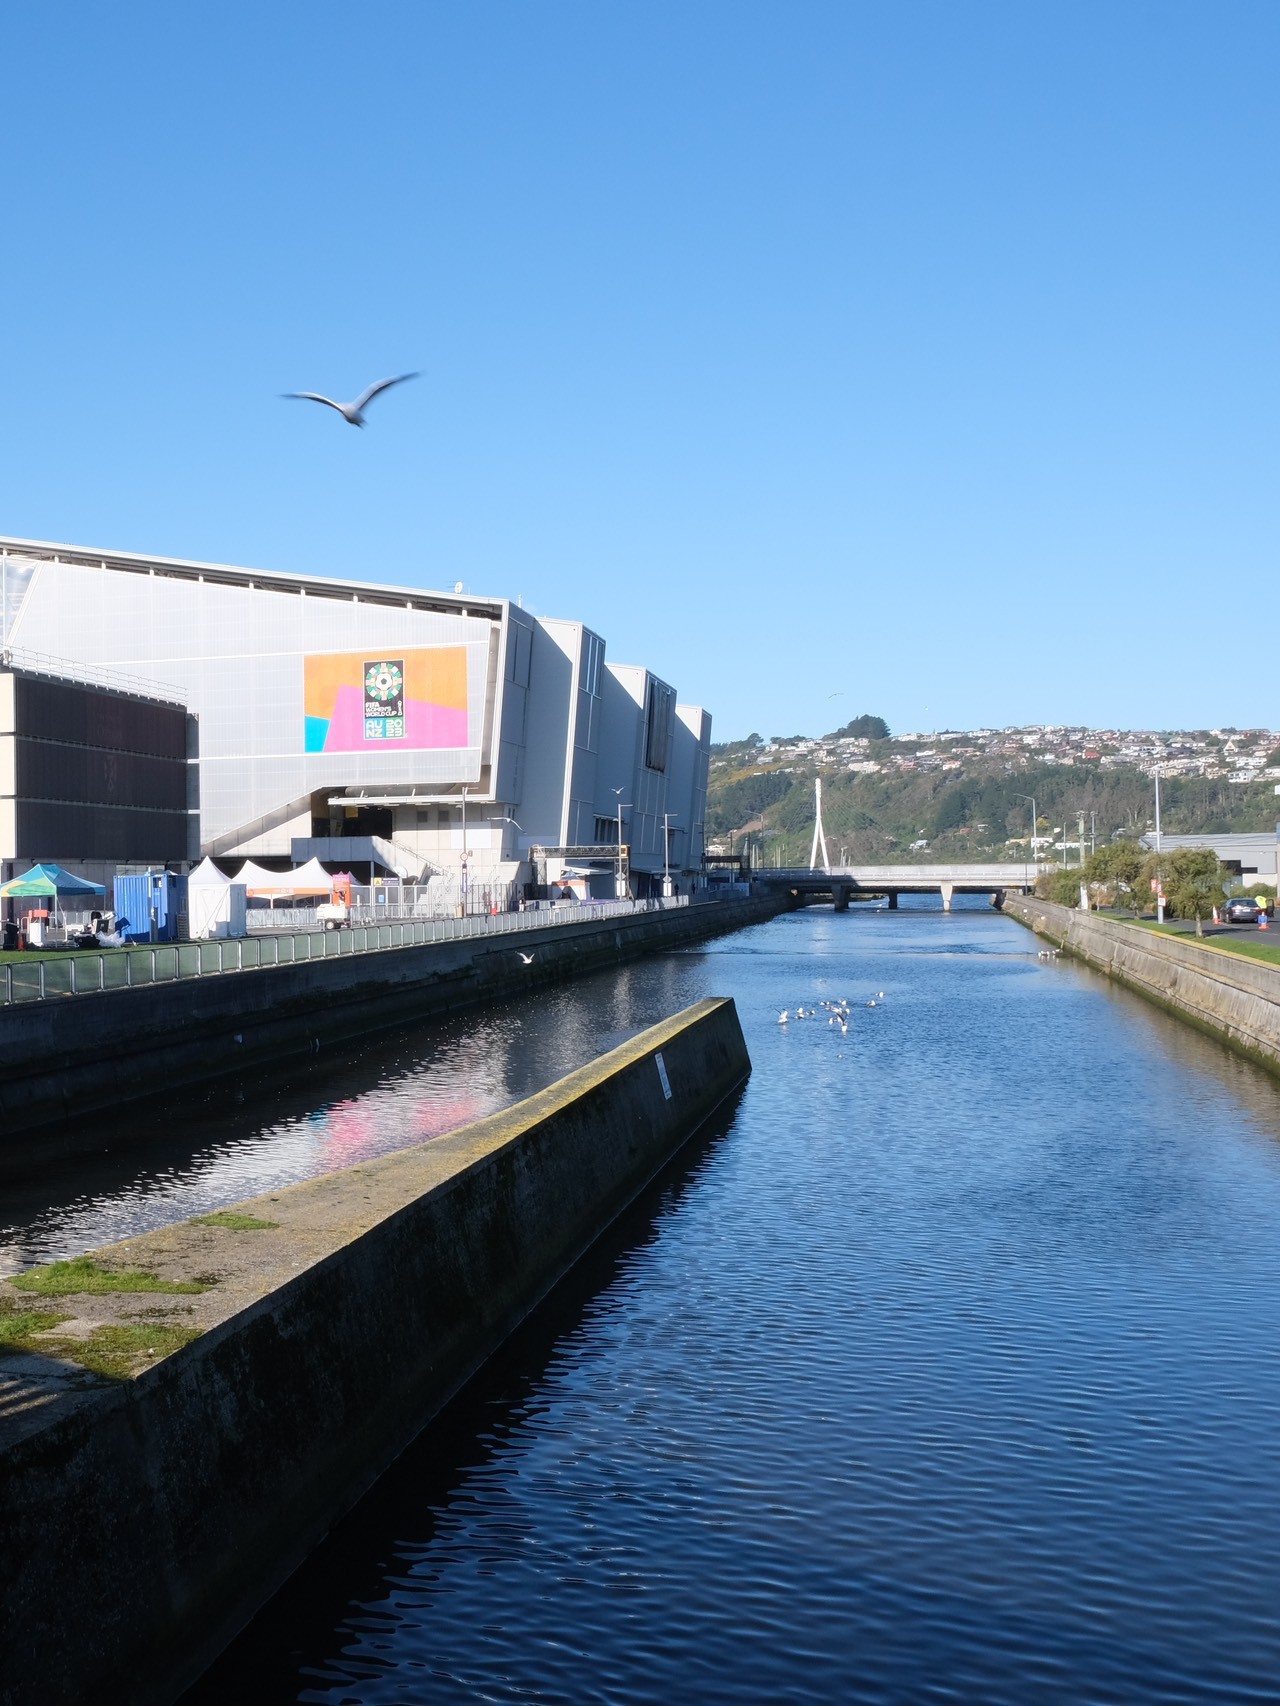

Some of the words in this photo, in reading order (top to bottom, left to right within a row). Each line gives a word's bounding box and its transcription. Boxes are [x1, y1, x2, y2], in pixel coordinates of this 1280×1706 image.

[366, 720, 383, 728] AU
[386, 720, 402, 728] 20
[366, 729, 383, 737] NZ
[386, 728, 402, 736] 23
